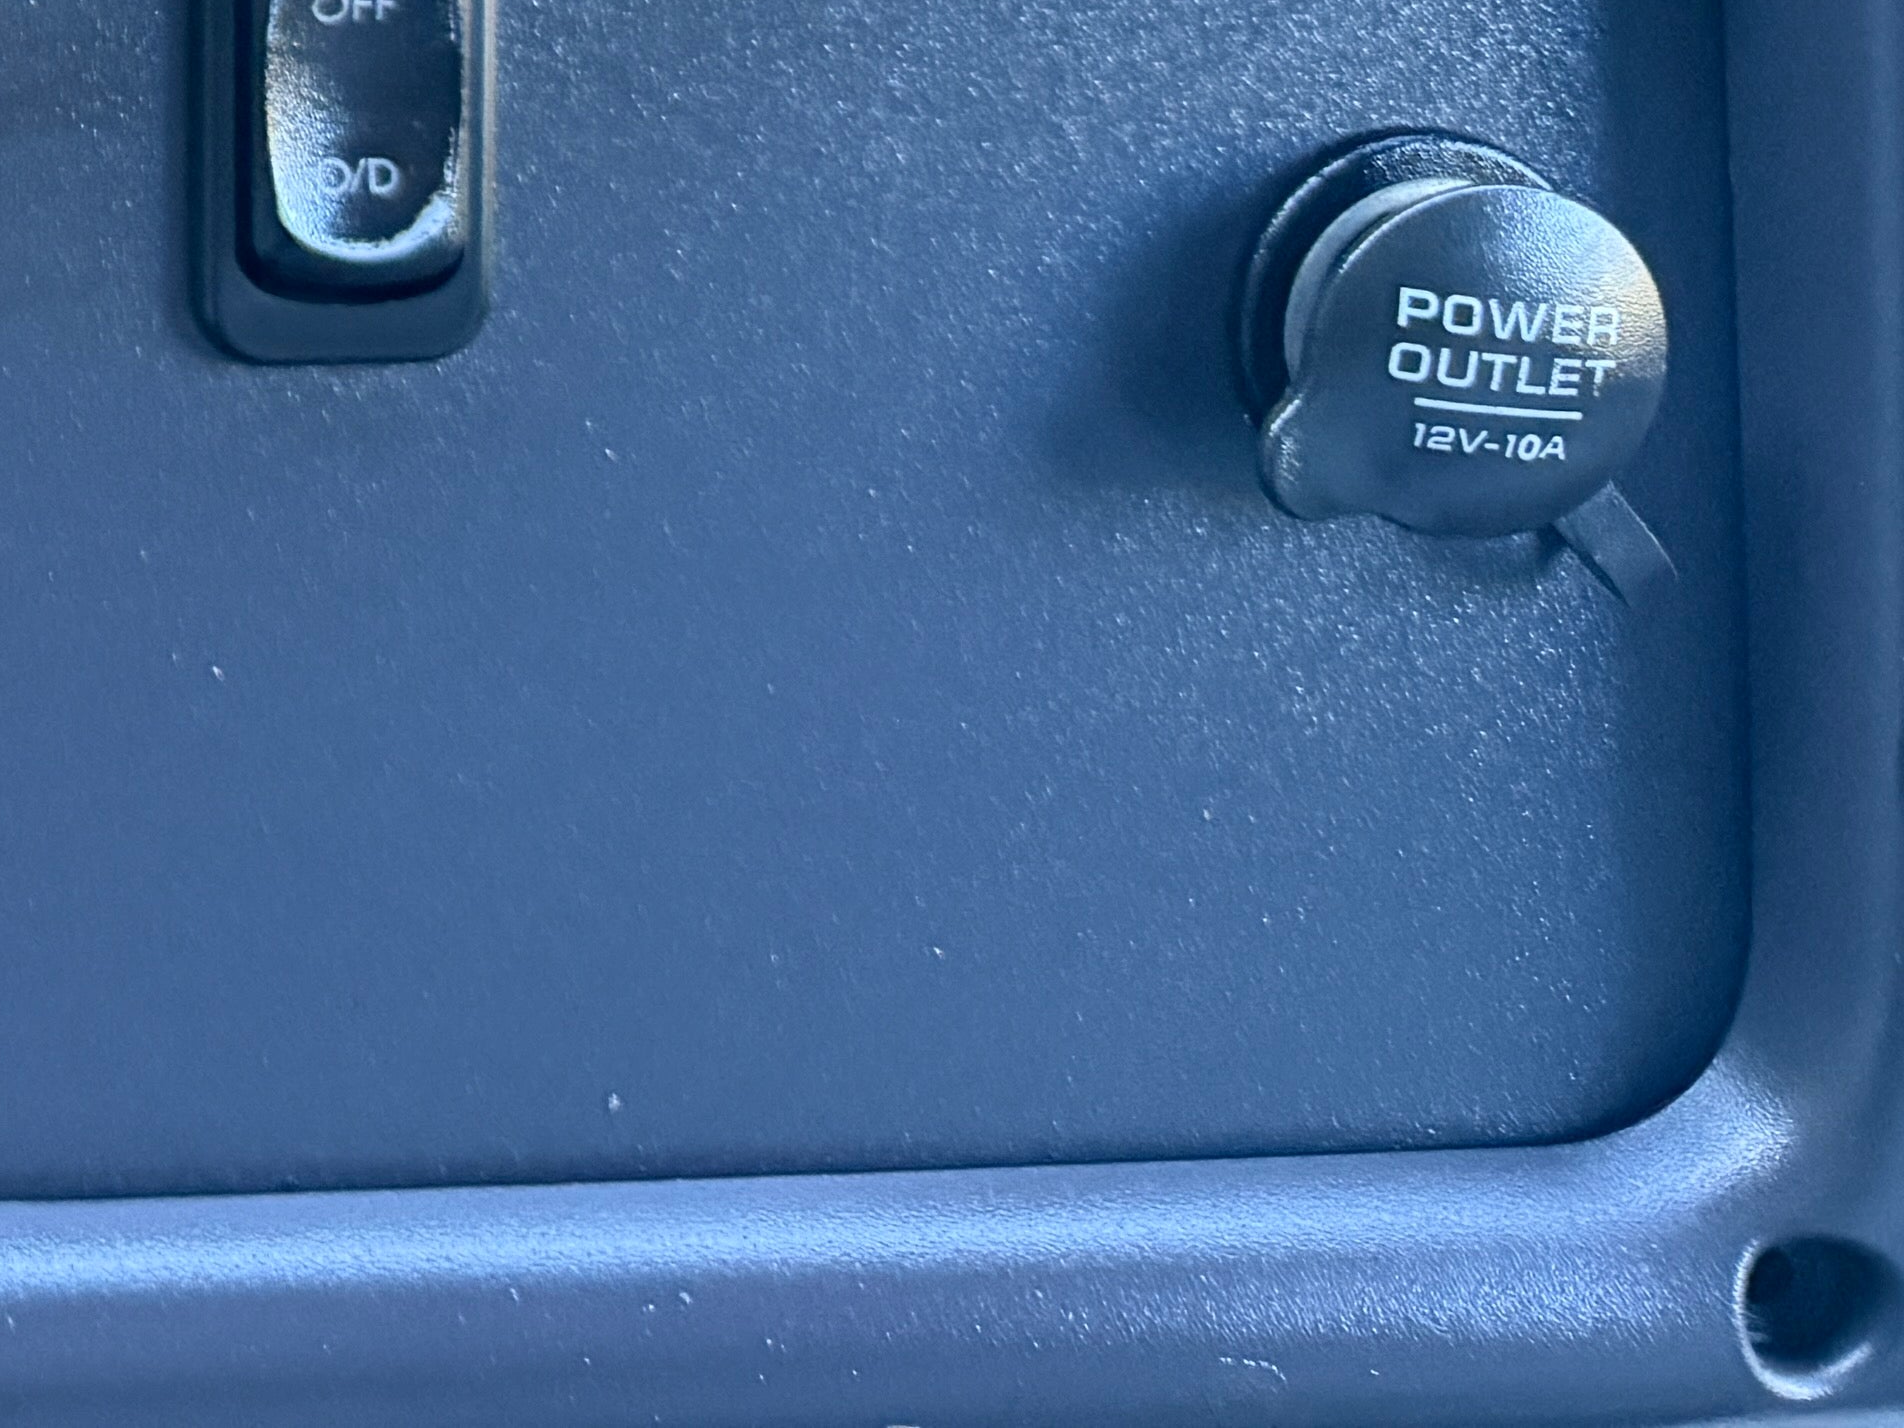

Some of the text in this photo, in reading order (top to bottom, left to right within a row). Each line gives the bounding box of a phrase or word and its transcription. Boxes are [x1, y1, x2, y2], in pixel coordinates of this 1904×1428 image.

[320, 156, 402, 196] O/D
[1395, 285, 1624, 347] POWER
[1386, 341, 1617, 398] OUTLET
[1411, 421, 1568, 462] 12V-10A
